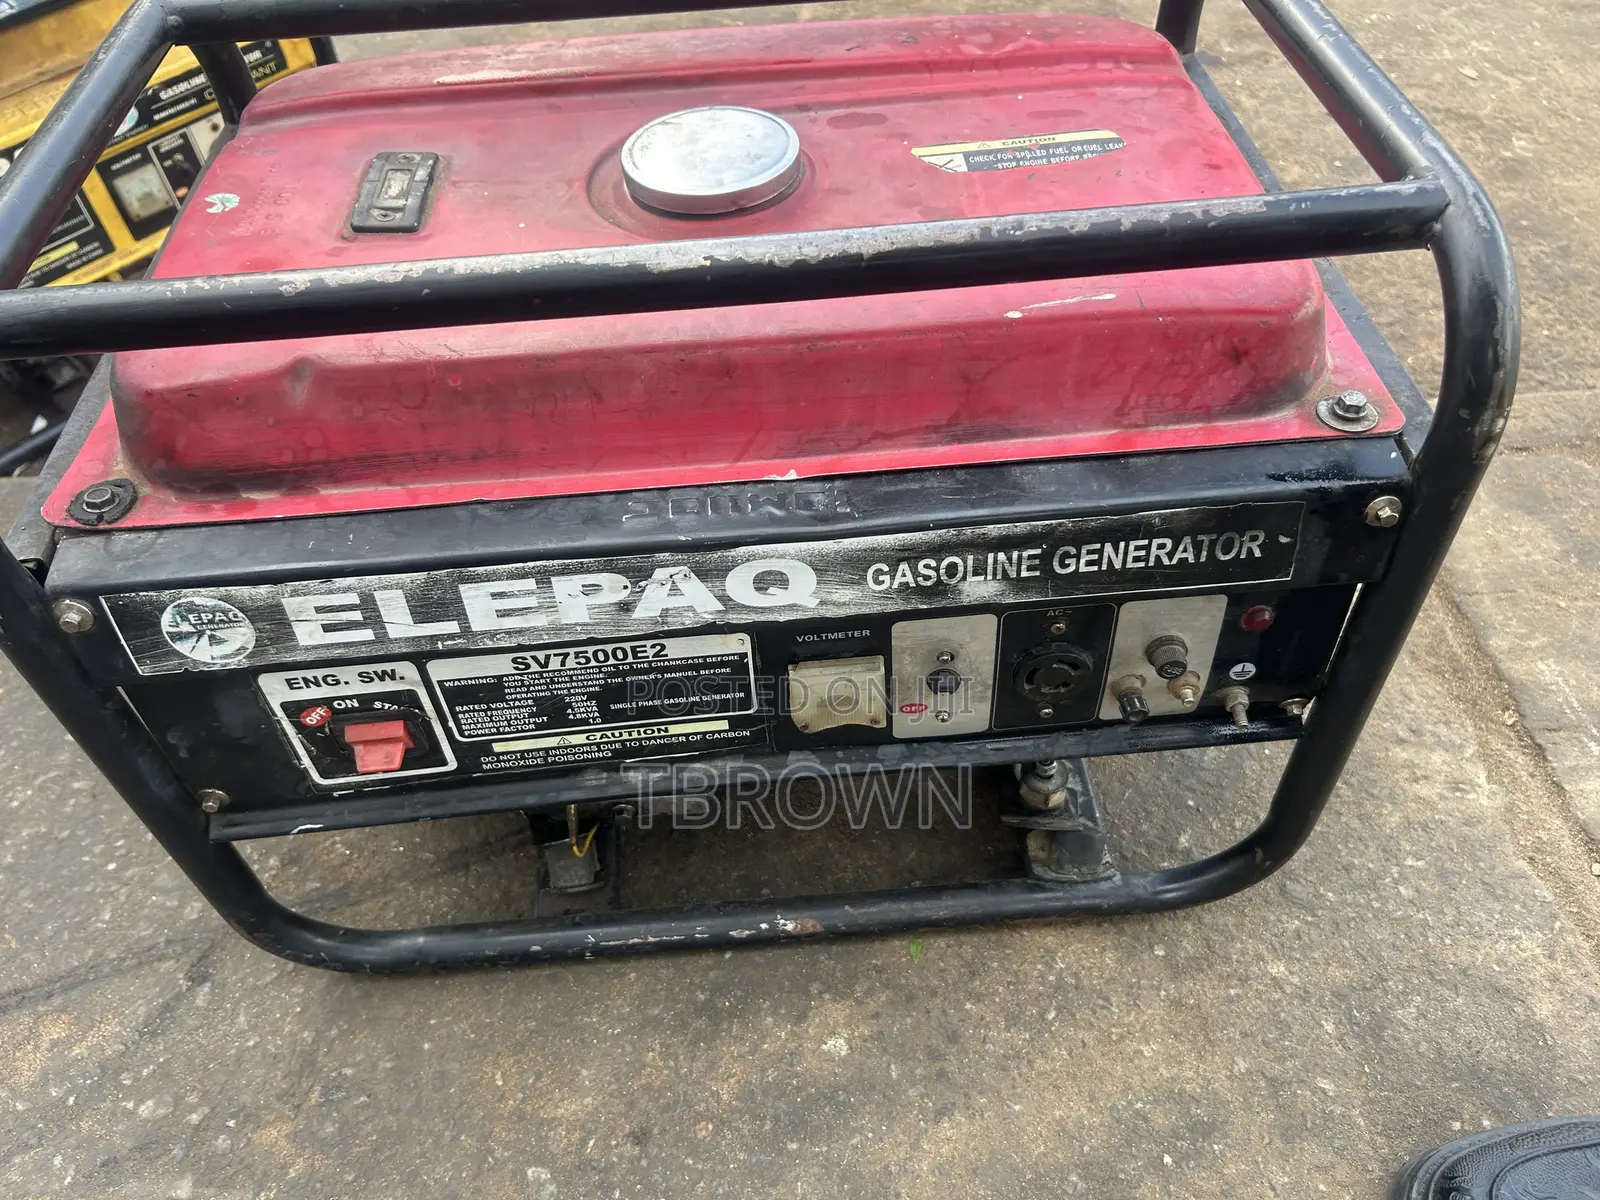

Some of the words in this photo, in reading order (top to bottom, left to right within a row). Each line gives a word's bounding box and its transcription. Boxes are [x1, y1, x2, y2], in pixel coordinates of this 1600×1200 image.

[1001, 136, 1057, 146] CAUTION
[968, 154, 996, 164] CHECK
[1049, 146, 1069, 155] FUEL
[1071, 145, 1083, 153] OR
[1019, 158, 1049, 167] ENGINE
[281, 558, 820, 645] ELEPAQ
[866, 548, 1042, 591] GASOLINE
[1052, 529, 1266, 575] GENERATOR
[795, 629, 871, 643] VOLTMETER
[510, 642, 669, 672] SV7500E2
[443, 677, 498, 687] WARNING:
[502, 674, 522, 682] ADD
[524, 672, 541, 680] THE
[542, 667, 600, 679] RECOMMEND
[600, 665, 617, 673] OIL
[651, 657, 704, 668] CHANKCASE
[706, 655, 740, 663] BEFORE
[284, 673, 351, 691] ENG.
[357, 668, 406, 685] SW.
[503, 680, 523, 688] YOU
[523, 678, 551, 686] START
[572, 672, 608, 681] ENGINE.
[529, 684, 547, 692] AND
[549, 679, 605, 690] UNDERSTAND
[625, 673, 663, 682] OWNER'S
[664, 670, 695, 679] MANUEL
[505, 690, 551, 700] OPERATING
[571, 686, 603, 694] ENGINE.
[609, 701, 637, 710] SINGLE
[638, 699, 662, 708] PHASE
[664, 695, 701, 705] GASOLINE
[701, 692, 746, 701] GENERATOR
[333, 698, 360, 709] ON
[455, 704, 488, 712] RATED
[489, 699, 535, 709] VOLTAGE
[458, 711, 486, 719] RATED
[487, 706, 538, 718] FREQUENCY
[572, 700, 598, 708] 50HZ
[902, 705, 926, 713] OFF
[305, 706, 328, 726] OFF
[460, 716, 492, 725] RATED
[493, 712, 530, 722] OUTPUT
[462, 721, 508, 730] MAXIMUM
[510, 716, 549, 726] OUTPUT
[464, 728, 498, 736] POWER
[499, 723, 536, 733] FACTOR
[585, 726, 670, 742] CAUTION
[480, 755, 497, 763] DO
[499, 753, 522, 761] NOT
[524, 750, 546, 758] USE
[548, 745, 598, 756] INDOORS
[600, 742, 623, 750] DUE
[705, 730, 751, 740] CARBON
[482, 757, 546, 770] MONOXIDE
[547, 750, 613, 763] POISONING
